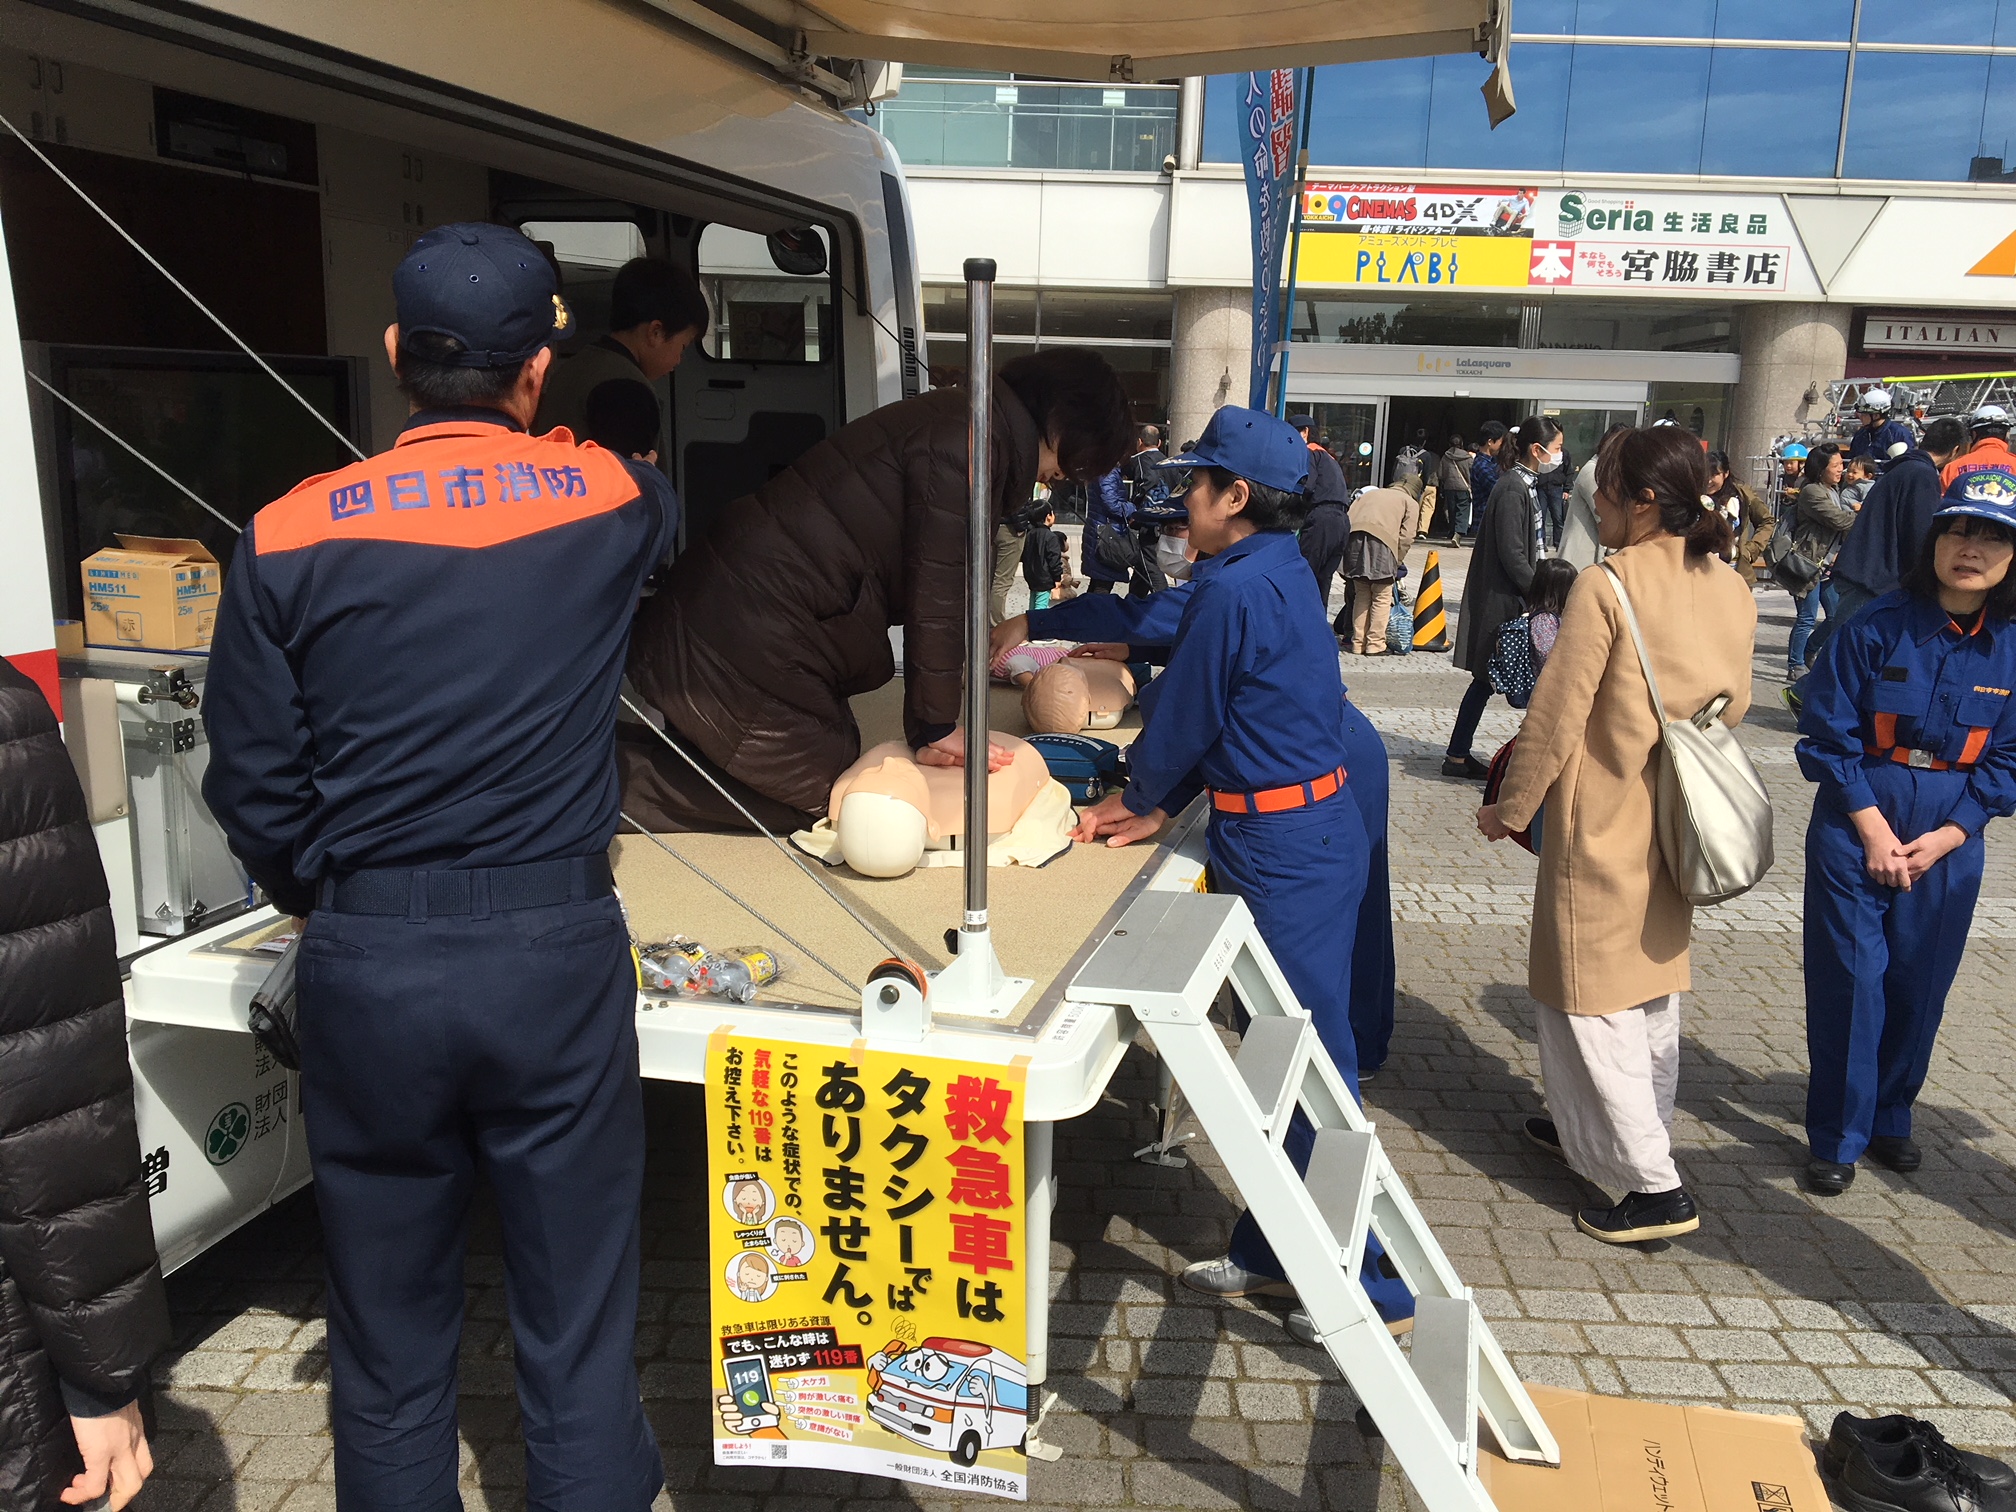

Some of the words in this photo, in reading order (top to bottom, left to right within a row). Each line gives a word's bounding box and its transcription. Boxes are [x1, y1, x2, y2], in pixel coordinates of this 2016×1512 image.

[1302, 194, 1347, 222] 109
[1346, 195, 1418, 222] CINEMAS
[1423, 197, 1486, 225] 4DX
[1558, 193, 1654, 232] Seria
[1663, 211, 1768, 236] 生活良品
[1359, 235, 1427, 247] アミューズメント
[1431, 237, 1459, 248] プレビ
[1356, 250, 1459, 285] PLABI
[1530, 243, 1573, 284] 本
[1579, 251, 1607, 260] 本なら
[1587, 260, 1615, 269] 何でも
[1621, 249, 1781, 286] 宮脇書店
[1596, 269, 1623, 278] そろう
[1885, 325, 2001, 343] ITALIAN
[329, 460, 588, 522] 四日市消防
[89, 582, 126, 593] HM511
[177, 583, 206, 596] HM511
[254, 1079, 288, 1117] 財団
[723, 1046, 745, 1164] お控え下さい。
[748, 1048, 774, 1163] 気軽な119番は
[254, 1106, 287, 1141] 法人
[780, 1053, 802, 1216] このような症状での、
[815, 1059, 874, 1327] ありません。
[881, 1067, 935, 1311] タクシーでは
[944, 1074, 1013, 1323] 救急車は
[735, 1230, 765, 1239] しゃっくりが
[721, 1315, 832, 1336] 救急車は限りある資源
[727, 1332, 830, 1354] でも、こんな時は
[734, 1370, 760, 1385] 119
[801, 1376, 827, 1387] 大ケガ
[798, 1392, 855, 1405] 胸が激しく痛む
[798, 1405, 861, 1424] 突然の激しい頭痛
[809, 1422, 850, 1440] 意識がない
[886, 1462, 938, 1479] 一般財団法人
[940, 1469, 1020, 1495] 全国消防協会
